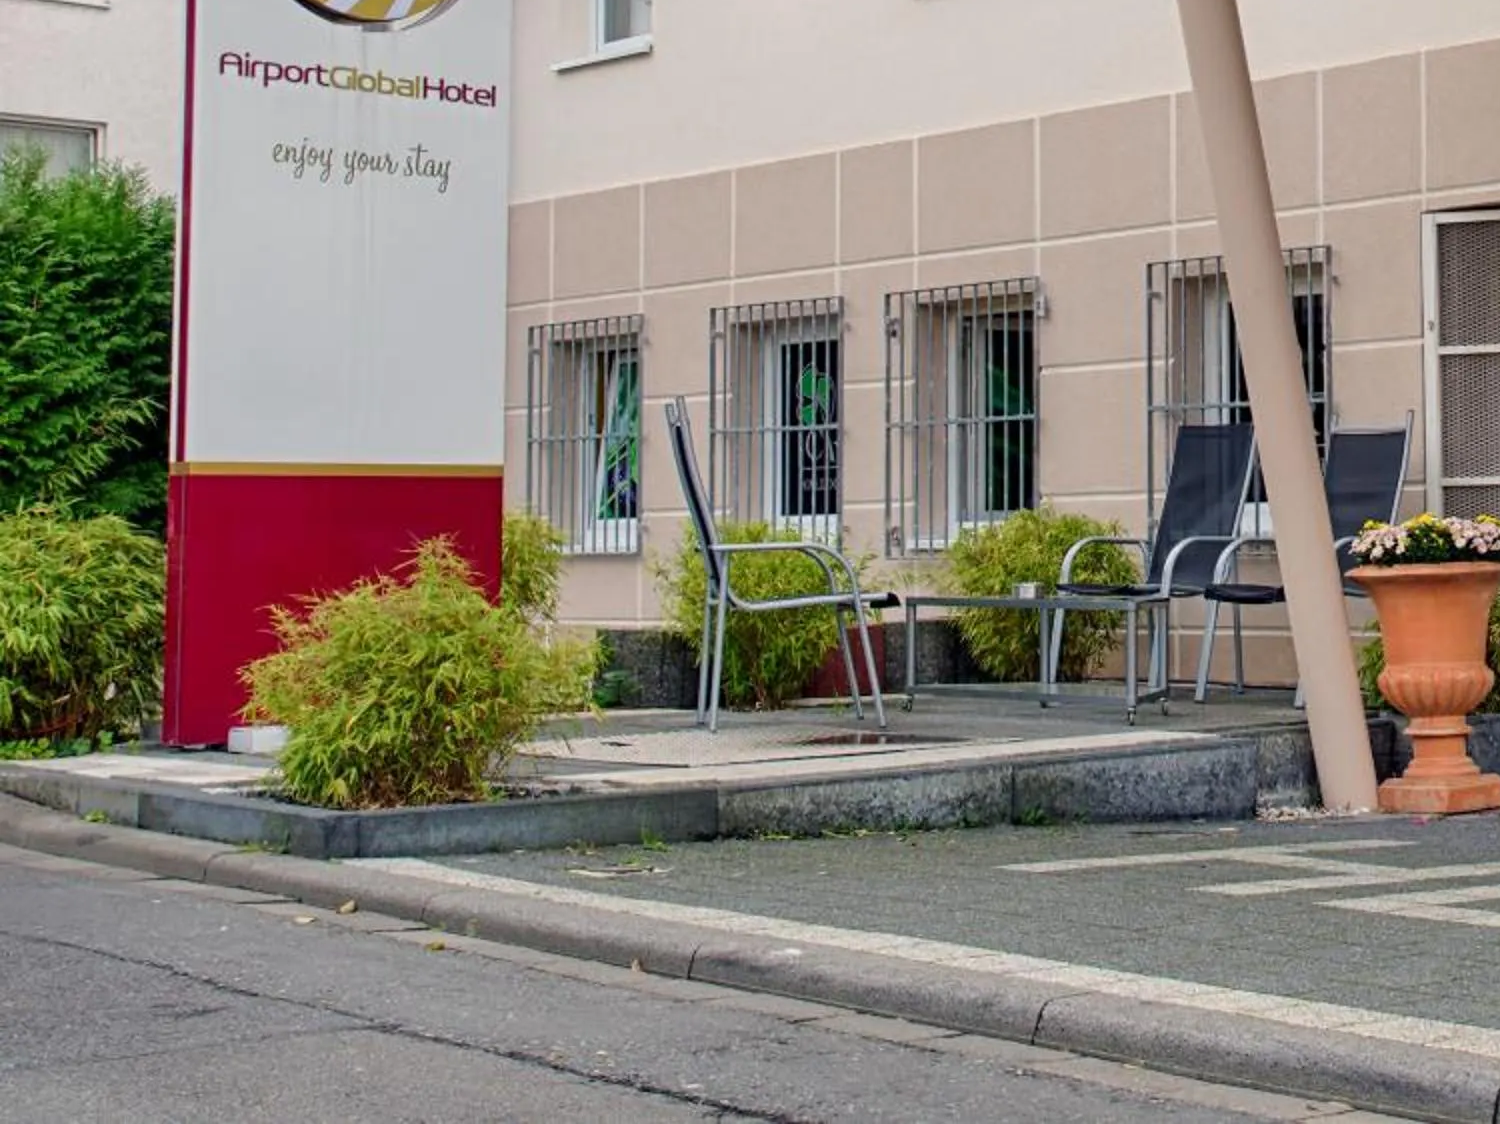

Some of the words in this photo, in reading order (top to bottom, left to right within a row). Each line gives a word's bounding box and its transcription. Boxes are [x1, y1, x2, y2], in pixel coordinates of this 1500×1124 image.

[272, 137, 333, 183] enjoy
[344, 151, 399, 185] your
[403, 143, 451, 193] stay
